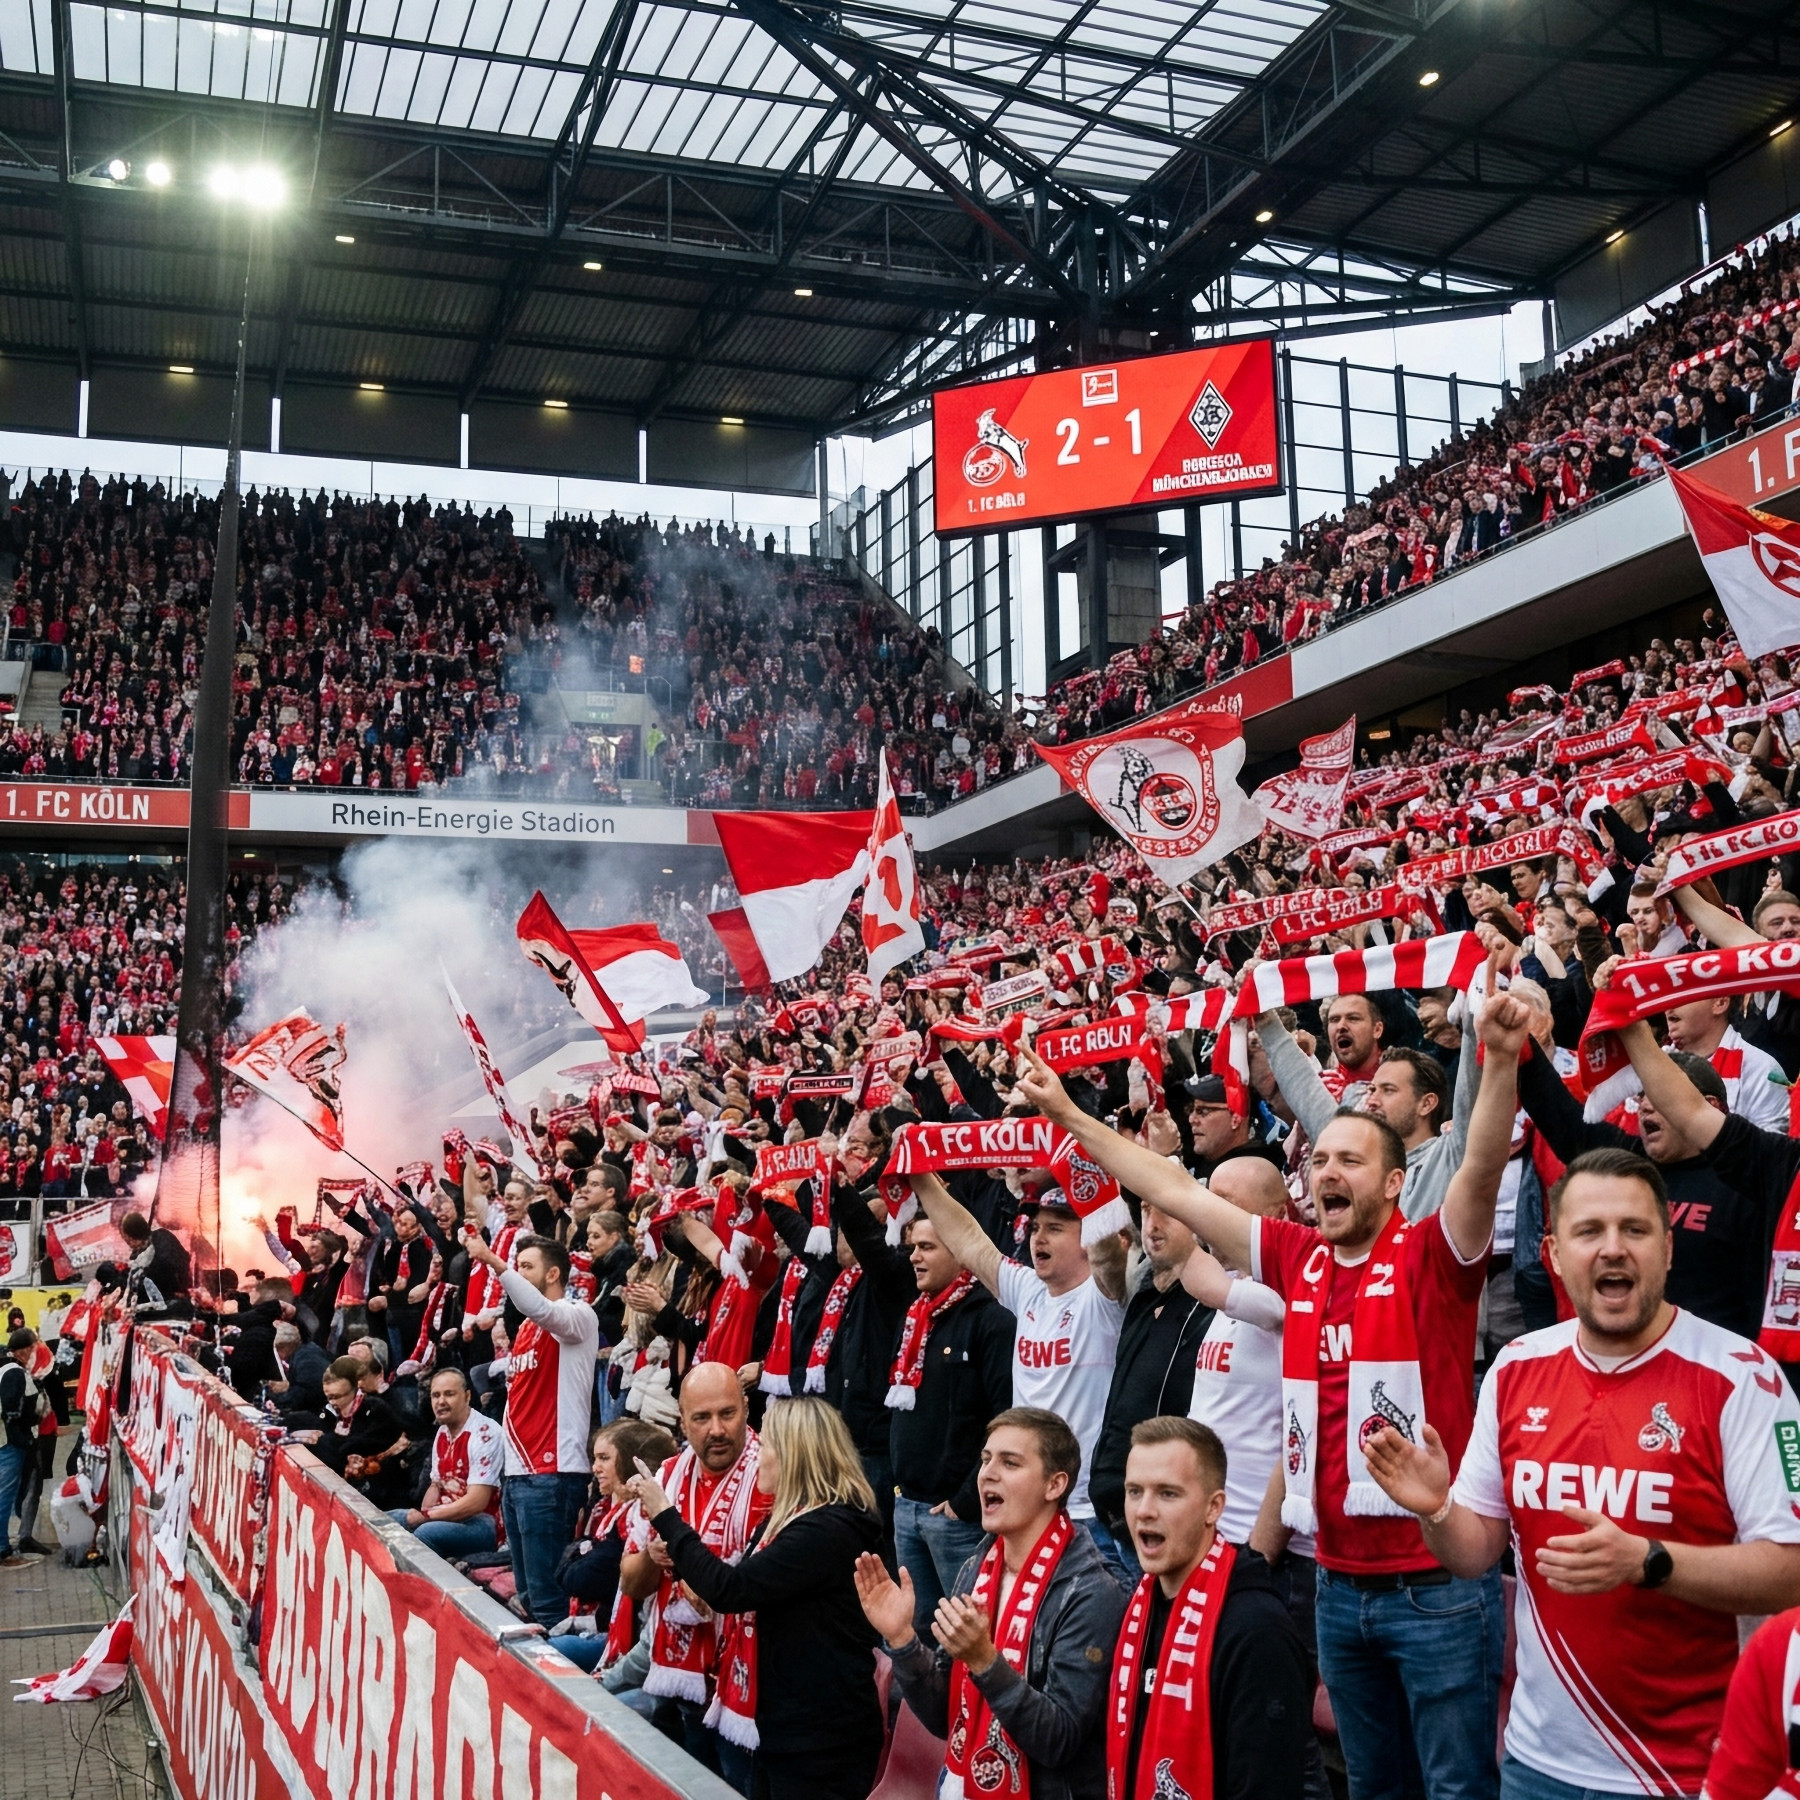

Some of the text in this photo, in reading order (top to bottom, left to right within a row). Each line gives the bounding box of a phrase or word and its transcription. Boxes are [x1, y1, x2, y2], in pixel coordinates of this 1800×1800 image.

[1056, 417, 1080, 466] 2
[1124, 408, 1142, 455] 1
[1748, 447, 1775, 494] 1.
[6, 788, 150, 820] 1. FC KÖLN
[332, 802, 616, 834] Rhein-Energie Stadion
[1621, 973, 1660, 1000] 1.
[1663, 954, 1722, 988] FC
[918, 1117, 1054, 1157] 1. FC KÖLN
[1511, 1458, 1675, 1525] REWE
